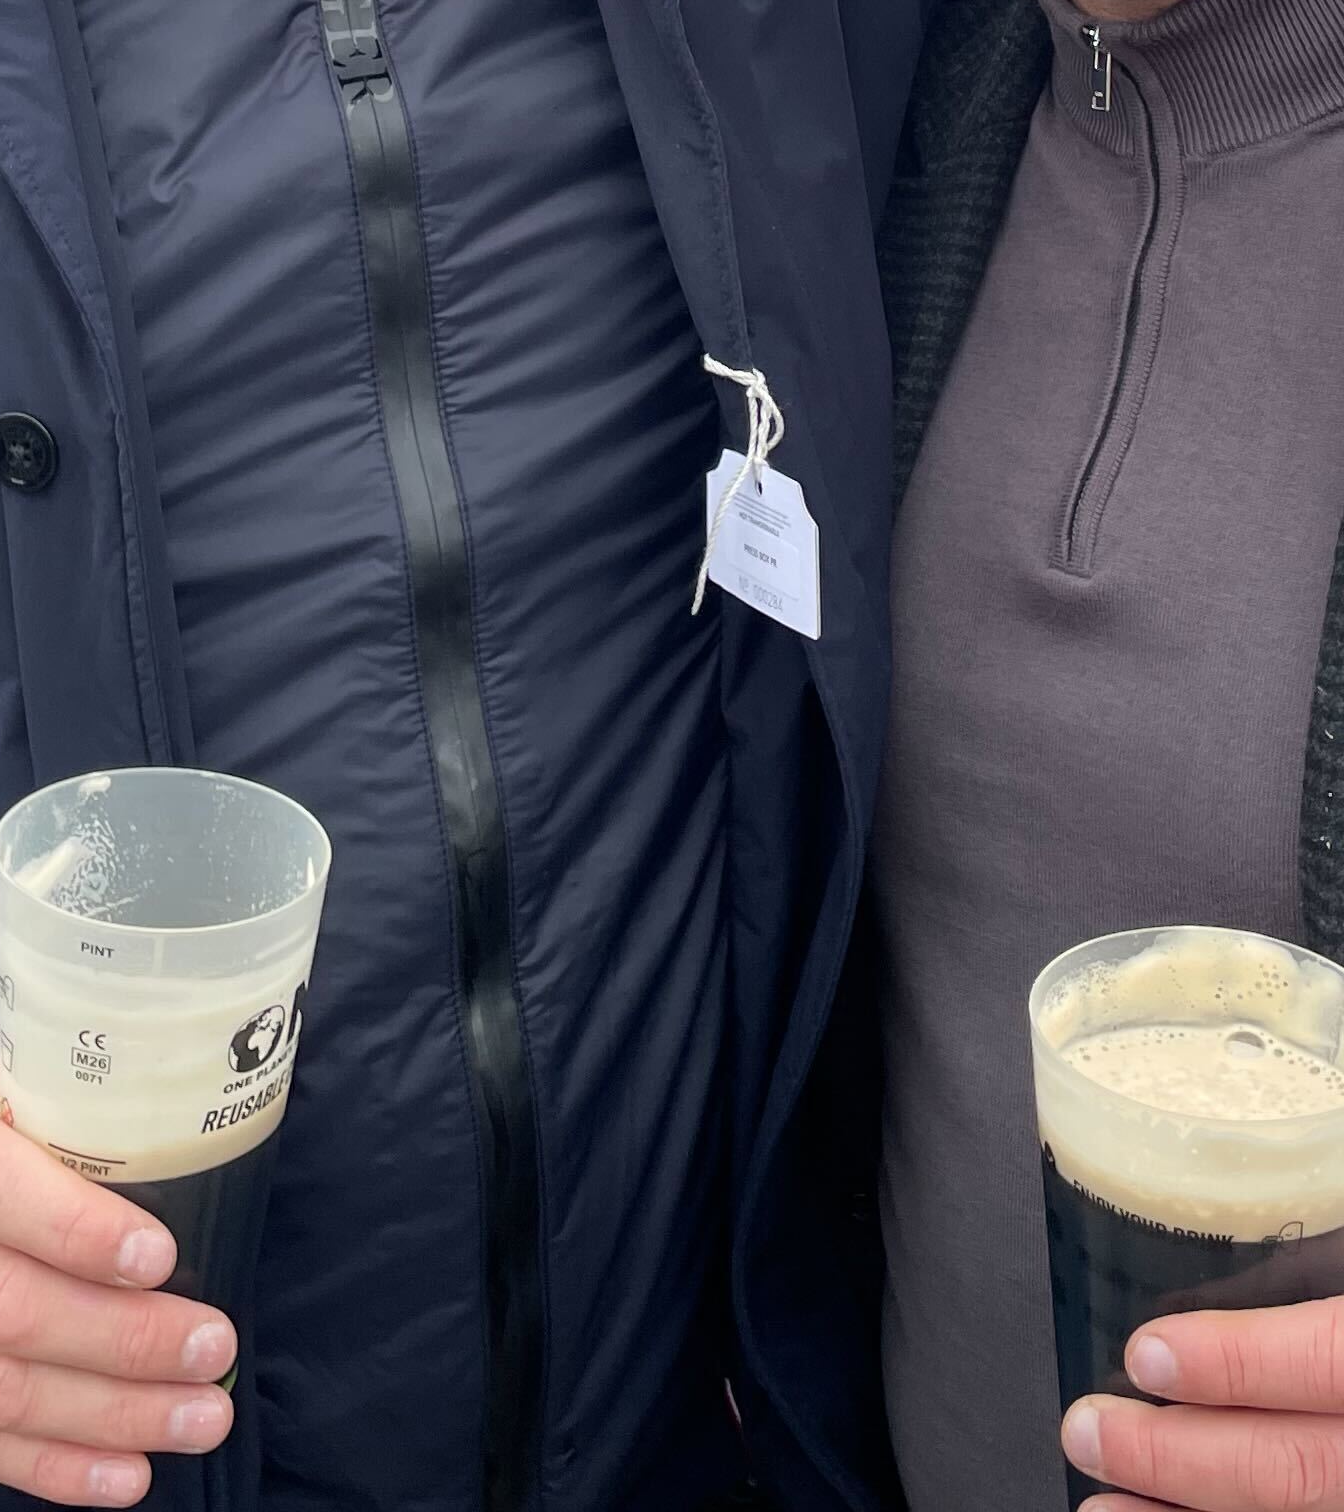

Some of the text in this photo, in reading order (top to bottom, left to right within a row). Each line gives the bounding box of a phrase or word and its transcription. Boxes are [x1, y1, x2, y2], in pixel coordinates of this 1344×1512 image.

[81, 941, 115, 959] PINT
[76, 1052, 107, 1070] M26
[75, 1070, 103, 1085] 0071
[223, 1075, 253, 1094] ONE
[80, 1161, 111, 1177] PINT
